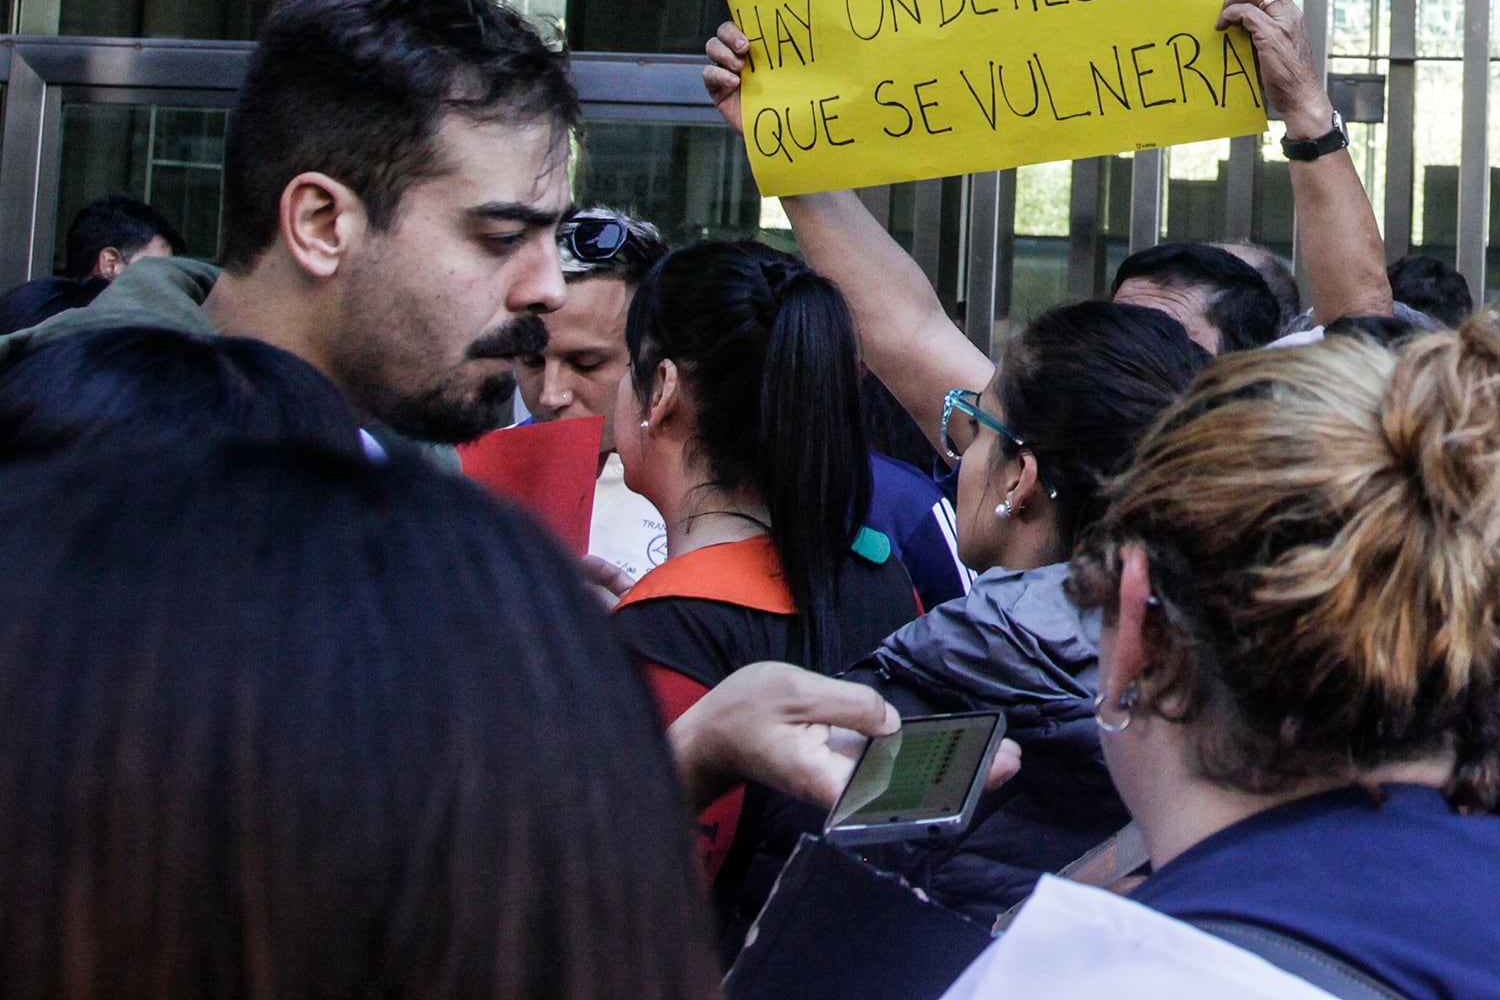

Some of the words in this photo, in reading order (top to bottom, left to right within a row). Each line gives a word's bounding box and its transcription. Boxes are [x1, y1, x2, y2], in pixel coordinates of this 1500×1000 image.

[752, 95, 855, 163] QUE
[873, 78, 953, 138] SE
[959, 32, 1262, 131] VULNERA
